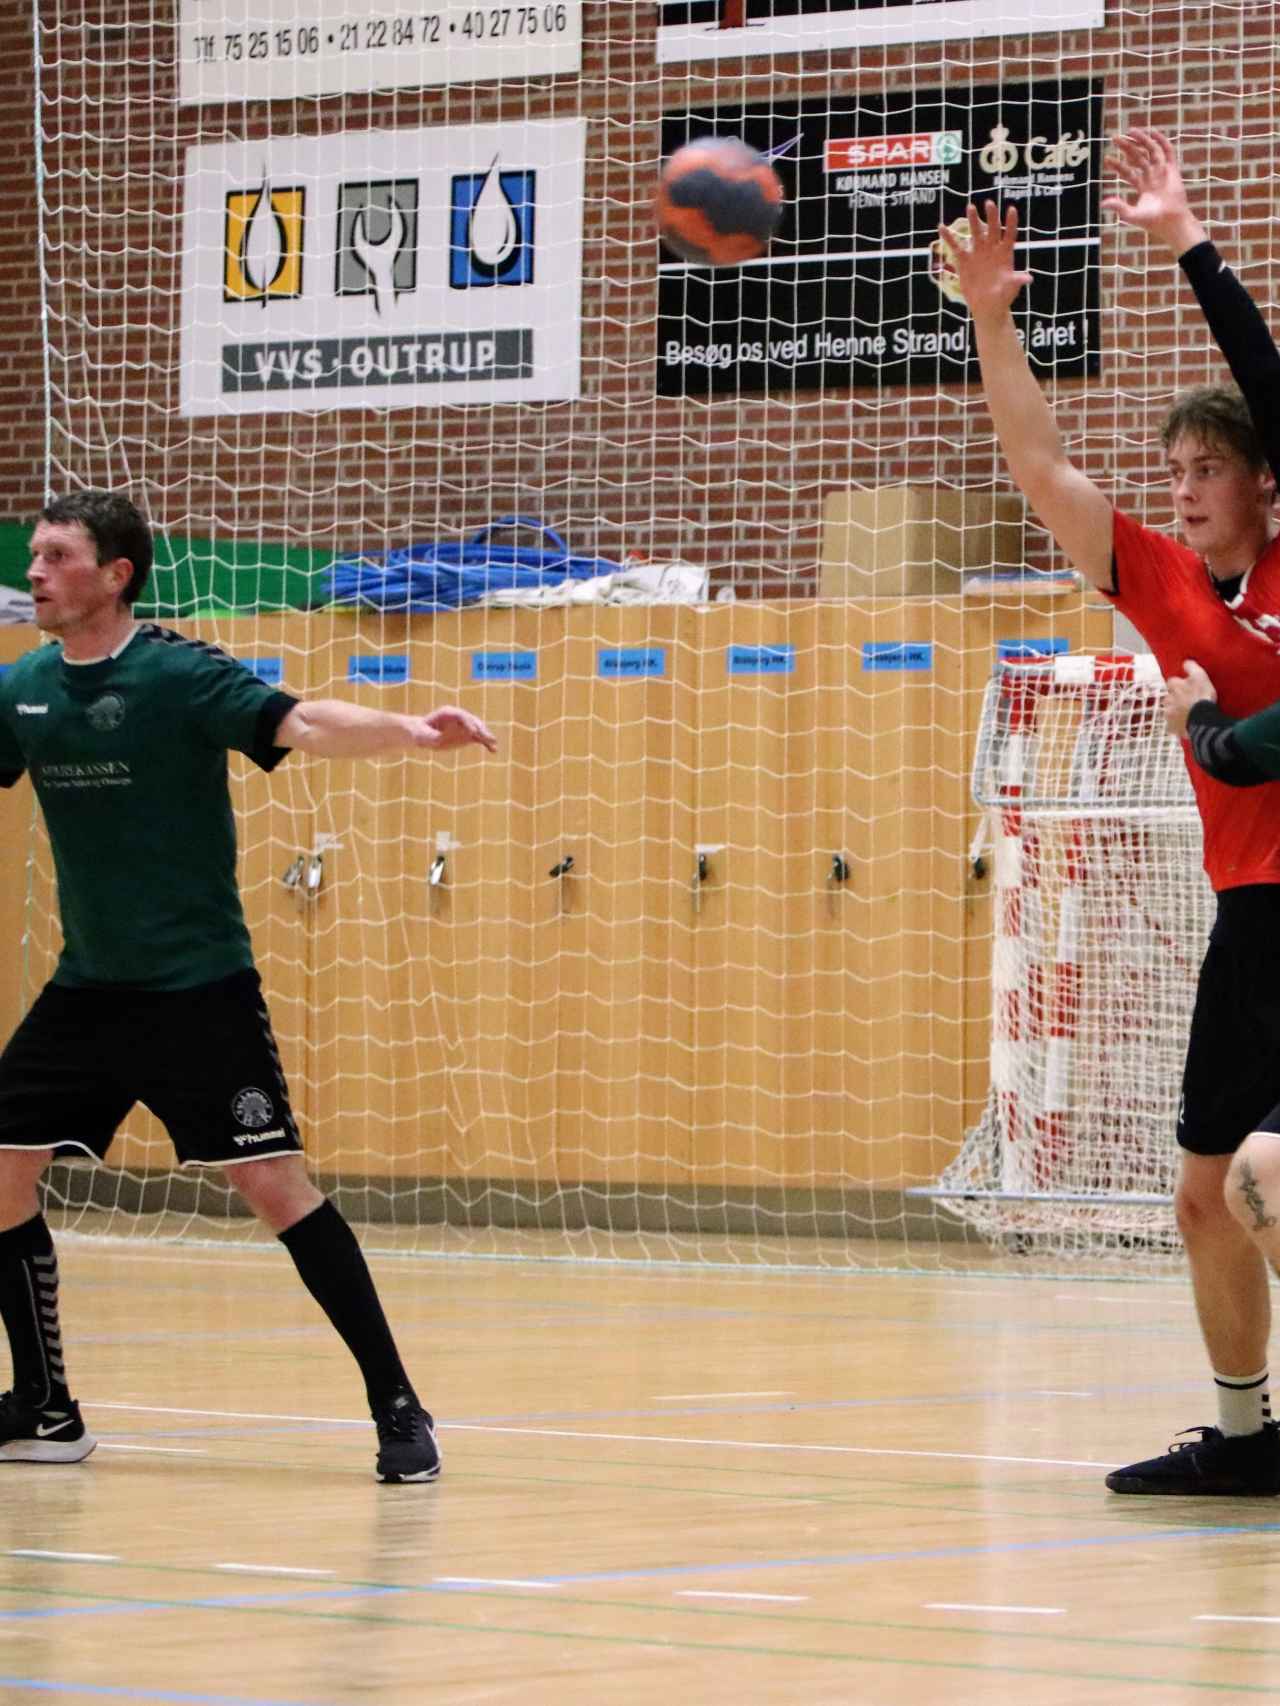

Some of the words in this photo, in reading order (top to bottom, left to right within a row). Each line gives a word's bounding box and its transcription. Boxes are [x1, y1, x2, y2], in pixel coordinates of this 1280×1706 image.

[224, 33, 243, 60] 75
[248, 31, 269, 58] 25
[275, 29, 292, 56] 15
[297, 26, 320, 54] 06
[340, 24, 359, 50] 21
[366, 20, 388, 49] 22
[392, 17, 414, 45] 84
[421, 15, 441, 43] 72
[462, 11, 484, 39] 40
[490, 8, 511, 37] 27
[517, 7, 538, 35] 75
[544, 4, 567, 33] 06
[848, 140, 930, 164] SPAR
[900, 169, 950, 186] HANSEN
[890, 188, 937, 207] STRAND
[255, 347, 323, 382] VVS
[350, 339, 497, 378] OUTRUP
[666, 340, 732, 369] Besøg
[738, 341, 763, 361] os
[769, 333, 808, 359] ved
[814, 331, 887, 358] Henne
[1031, 321, 1077, 348] året
